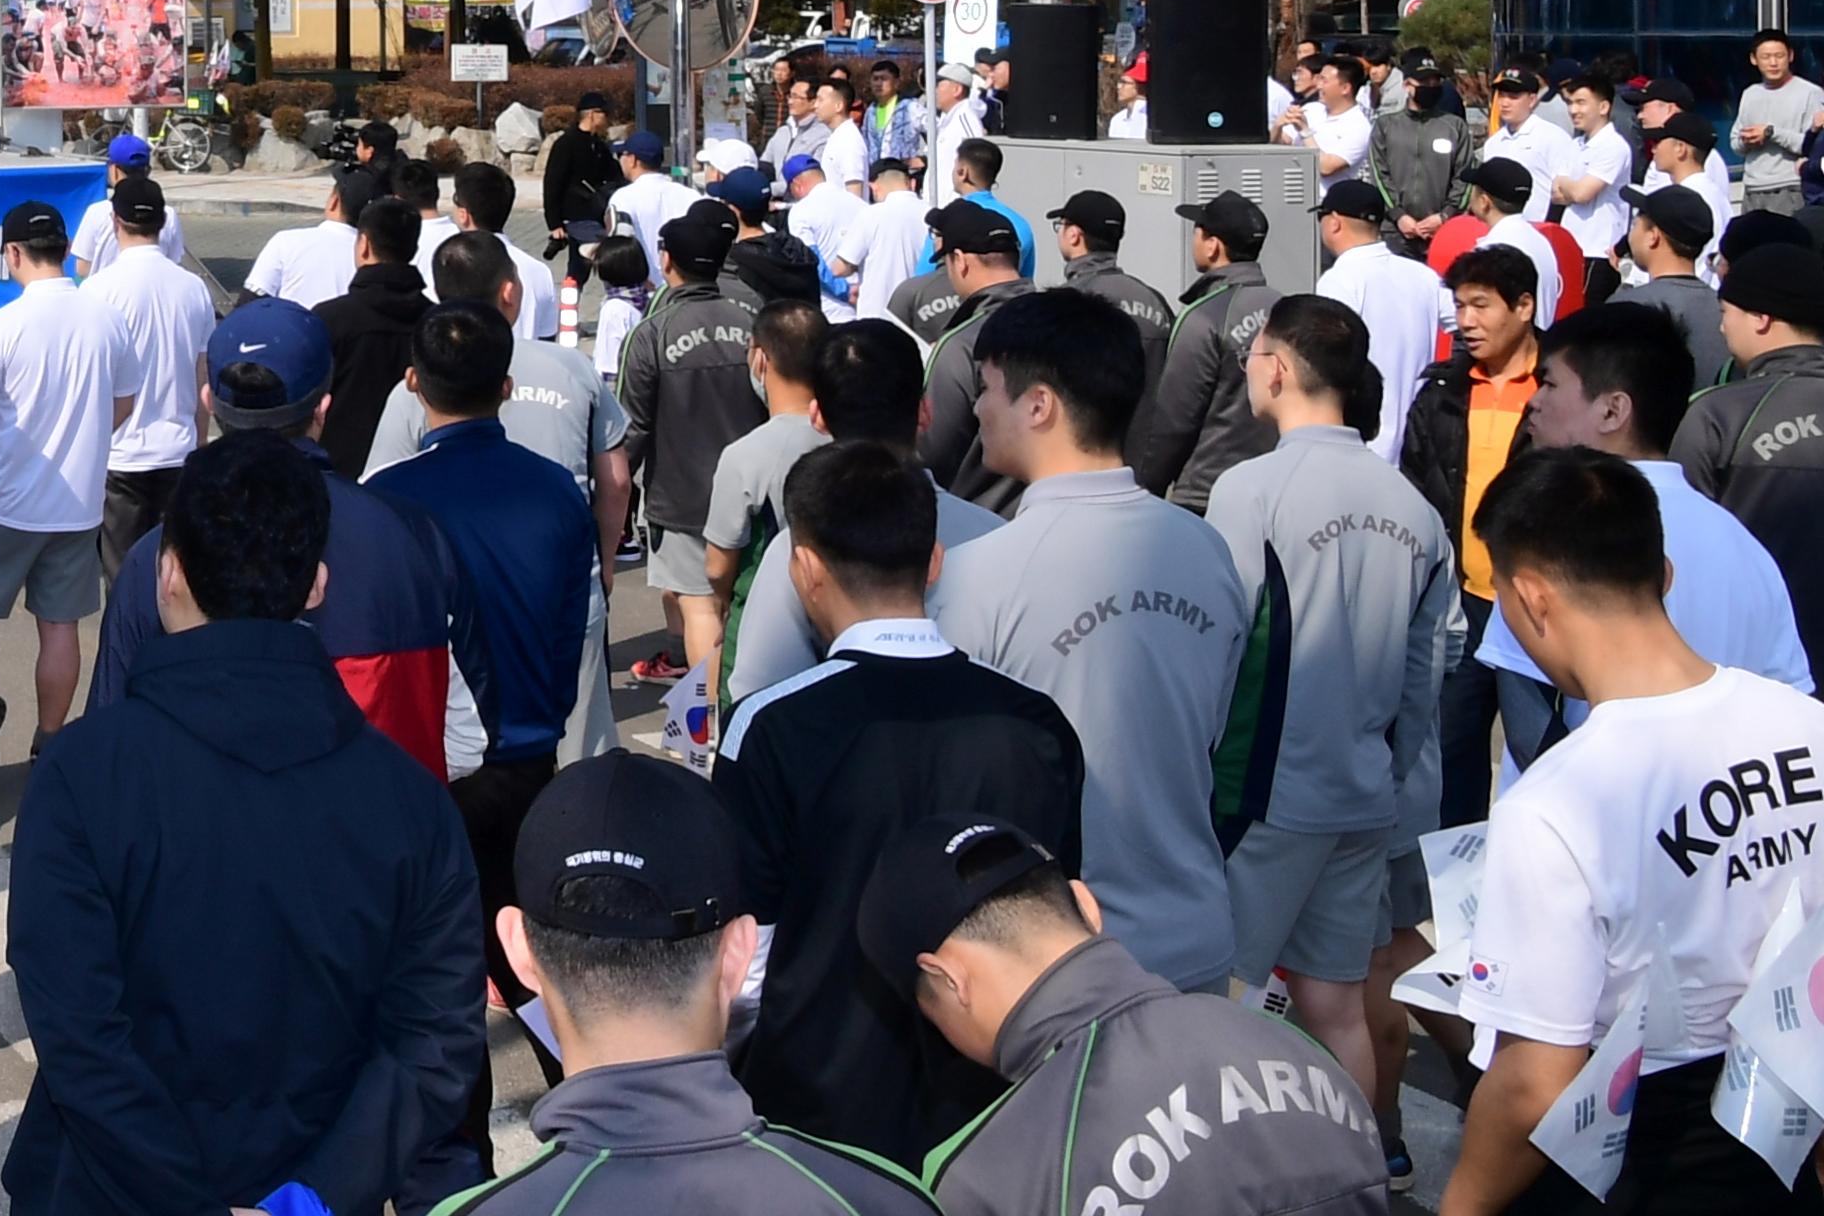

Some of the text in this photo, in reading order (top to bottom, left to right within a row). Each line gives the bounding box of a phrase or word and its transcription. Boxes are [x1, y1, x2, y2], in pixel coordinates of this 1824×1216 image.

[961, 2, 982, 21] 30
[1151, 175, 1170, 192] S22
[918, 295, 961, 323] ROK
[1229, 308, 1269, 345] ROK
[665, 326, 754, 364] ROK AR
[1751, 413, 1824, 462] ROK
[1307, 513, 1427, 561] ROK ARMY
[1051, 590, 1216, 657] ROK ARMY
[1726, 822, 1818, 890] ARMY
